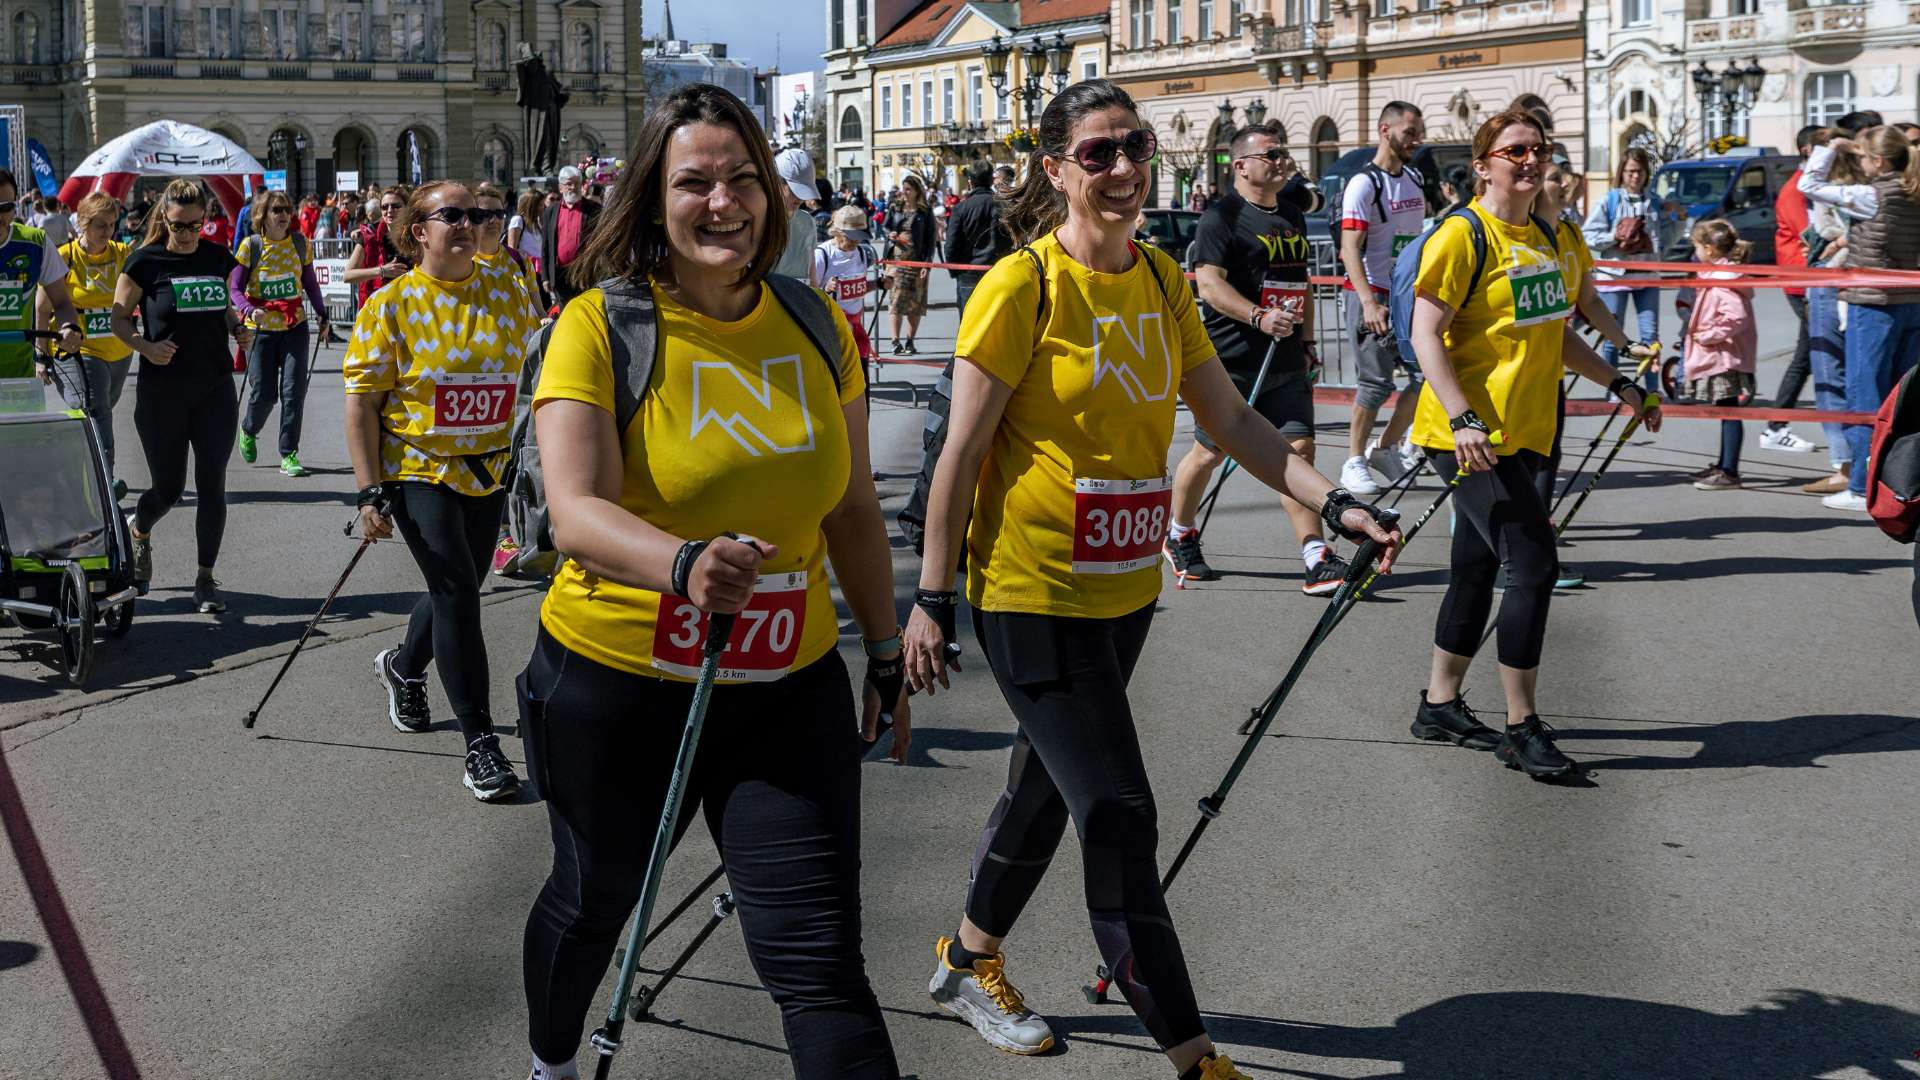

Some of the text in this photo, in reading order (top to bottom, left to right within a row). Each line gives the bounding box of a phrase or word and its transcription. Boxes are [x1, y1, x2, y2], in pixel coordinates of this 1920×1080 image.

[181, 285, 226, 302] 4123
[263, 281, 294, 296] 4113
[1518, 277, 1567, 311] 4184
[443, 389, 506, 422] 3297
[1084, 504, 1165, 548] 3088
[669, 603, 795, 653] 370
[731, 671, 746, 679] km
